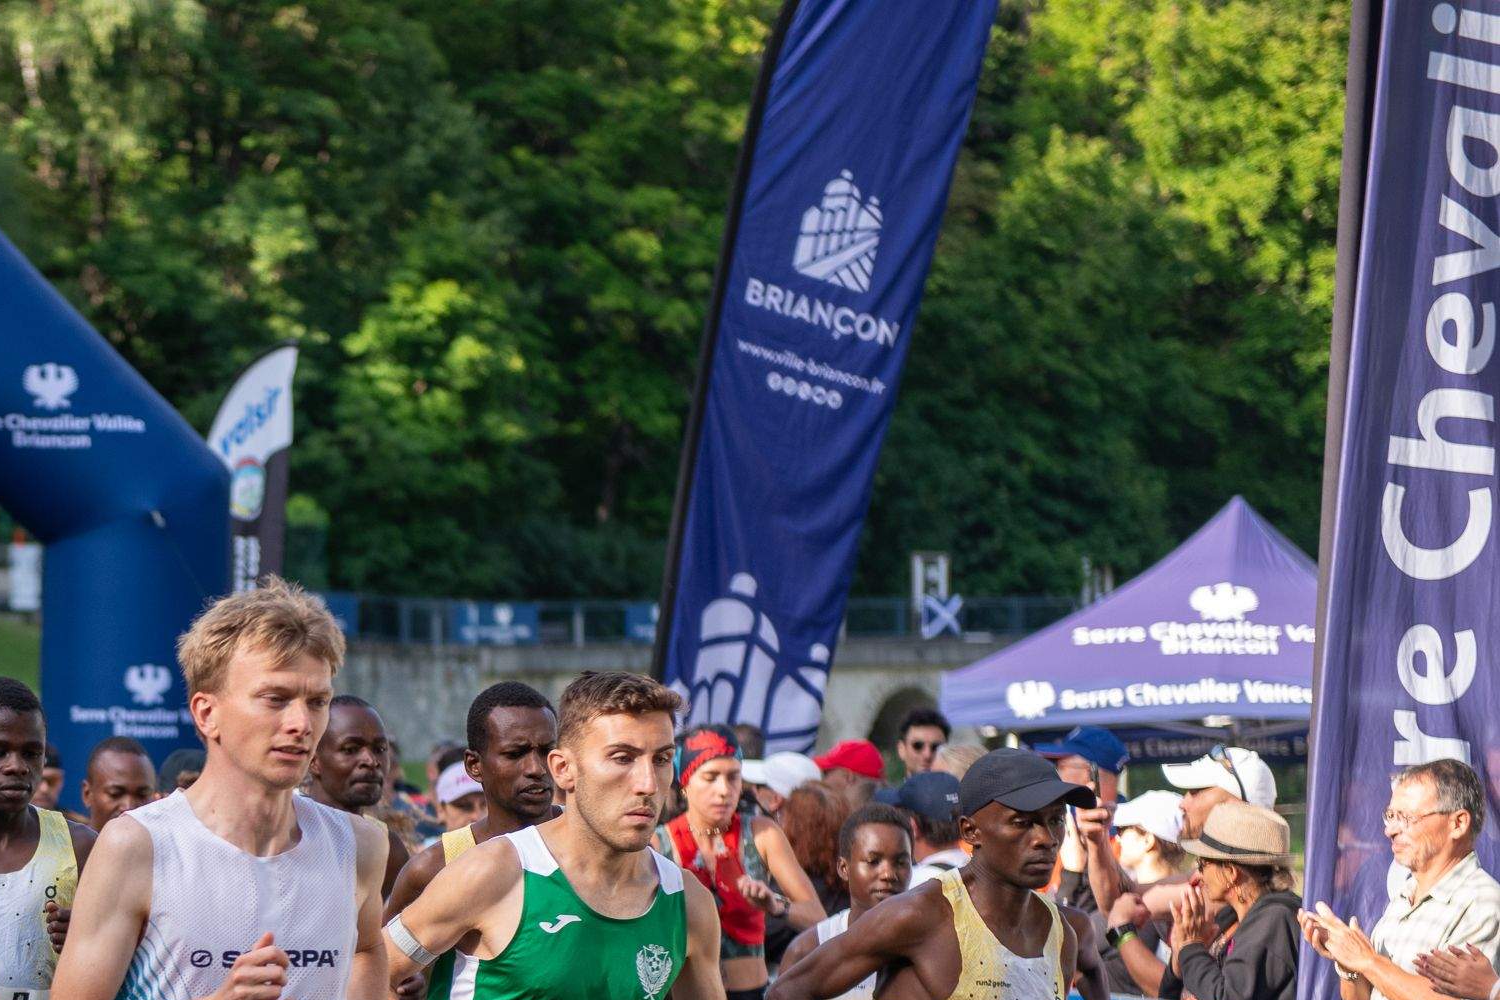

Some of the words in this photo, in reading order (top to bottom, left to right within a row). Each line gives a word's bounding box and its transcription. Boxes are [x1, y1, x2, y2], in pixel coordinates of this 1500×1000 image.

[745, 282, 899, 348] BRIANÇON
[1072, 627, 1146, 646] Serre
[1060, 687, 1124, 710] Serre
[1126, 678, 1240, 706] Chevalier
[222, 950, 334, 968] SRPA
